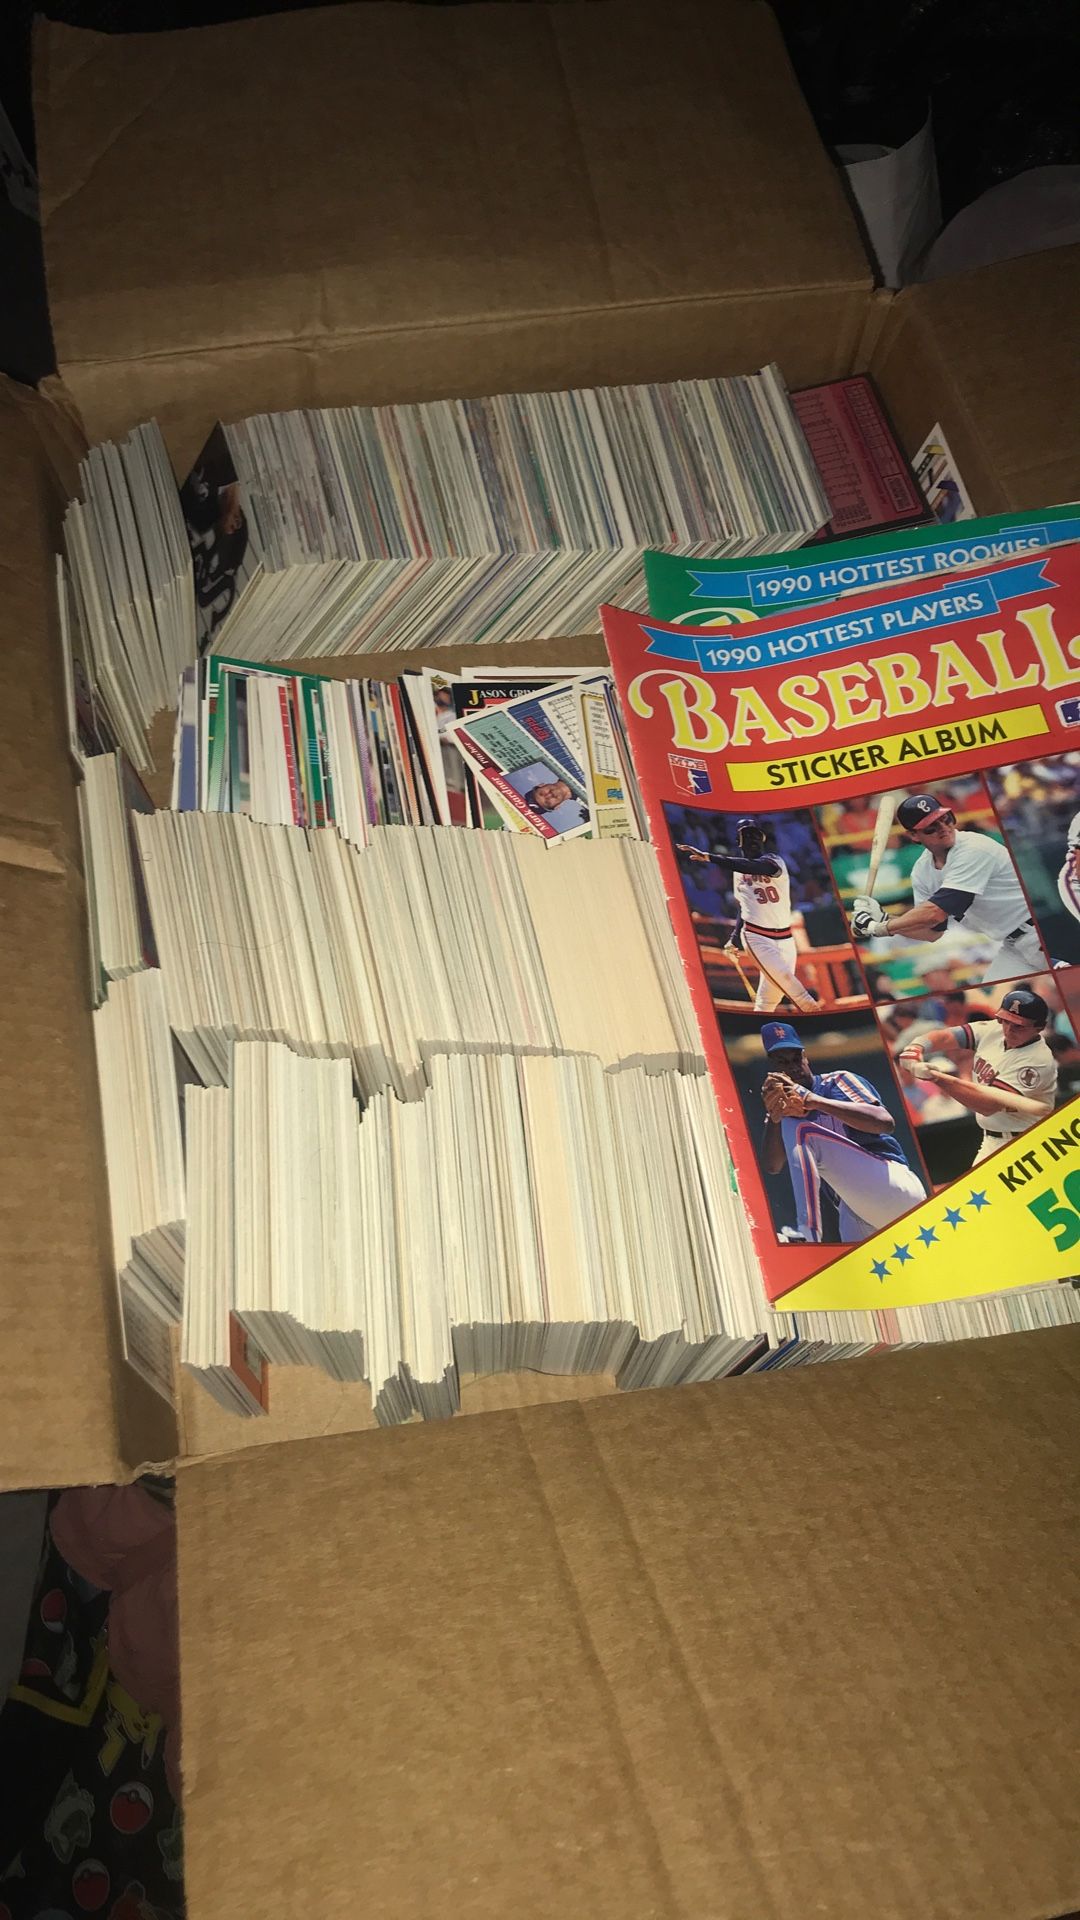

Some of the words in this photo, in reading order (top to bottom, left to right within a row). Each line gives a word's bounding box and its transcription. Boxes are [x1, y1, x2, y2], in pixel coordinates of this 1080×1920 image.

[756, 575, 812, 597] 1990
[819, 555, 926, 588] HOTTEST
[933, 537, 1041, 570] ROOKIES
[706, 646, 762, 666] 1990
[767, 617, 874, 658] HOTTEST
[881, 593, 984, 630] PLAYERS
[469, 690, 507, 705] JASON
[627, 603, 1080, 753] BASEBALL
[766, 744, 889, 787] STICKER
[898, 718, 1008, 762] ALBUM
[525, 809, 548, 831] Mark
[754, 886, 780, 904] 30
[998, 1150, 1044, 1193] KIT
